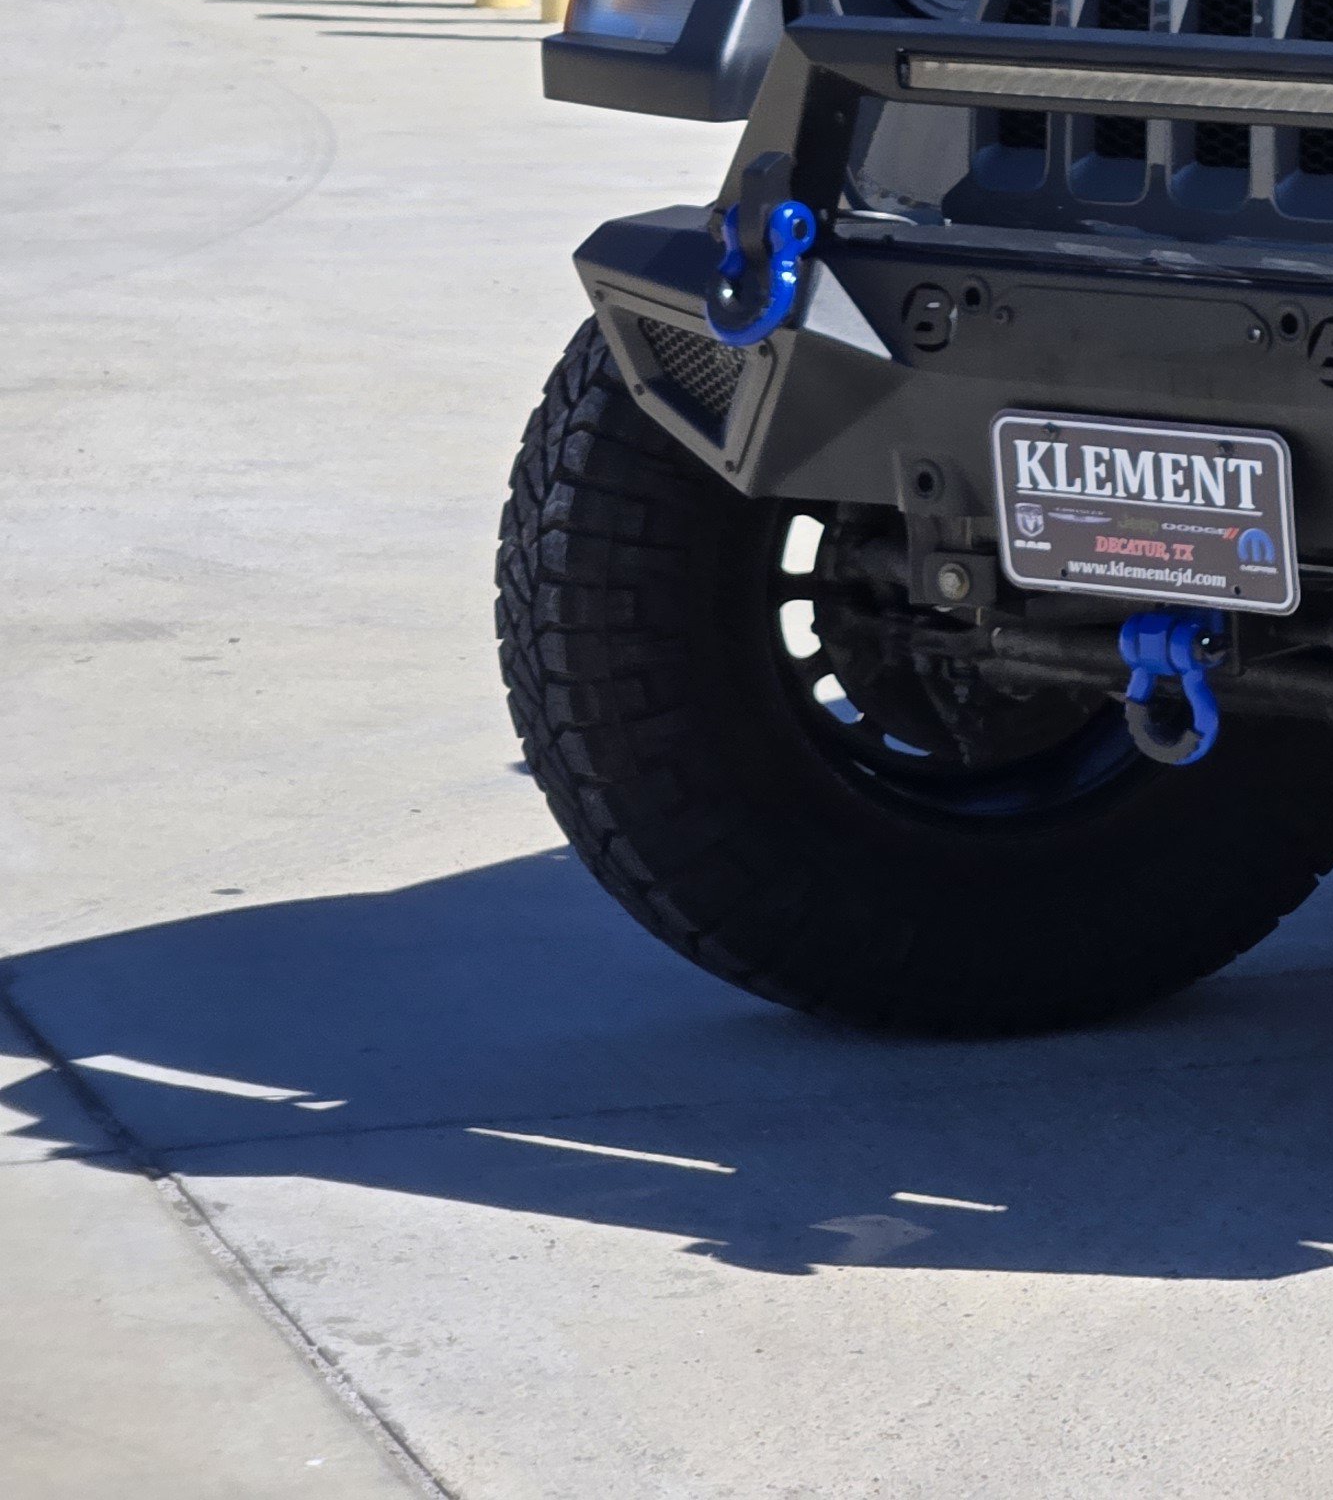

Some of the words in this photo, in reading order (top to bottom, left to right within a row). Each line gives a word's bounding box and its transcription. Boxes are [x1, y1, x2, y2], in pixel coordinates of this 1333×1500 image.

[1013, 439, 1263, 510] KLEMENT
[1161, 522, 1226, 536] DODGE
[1095, 535, 1171, 561] DECATUR,
[1172, 543, 1195, 562] TX
[1066, 560, 1228, 588] www.klementcjd.com
